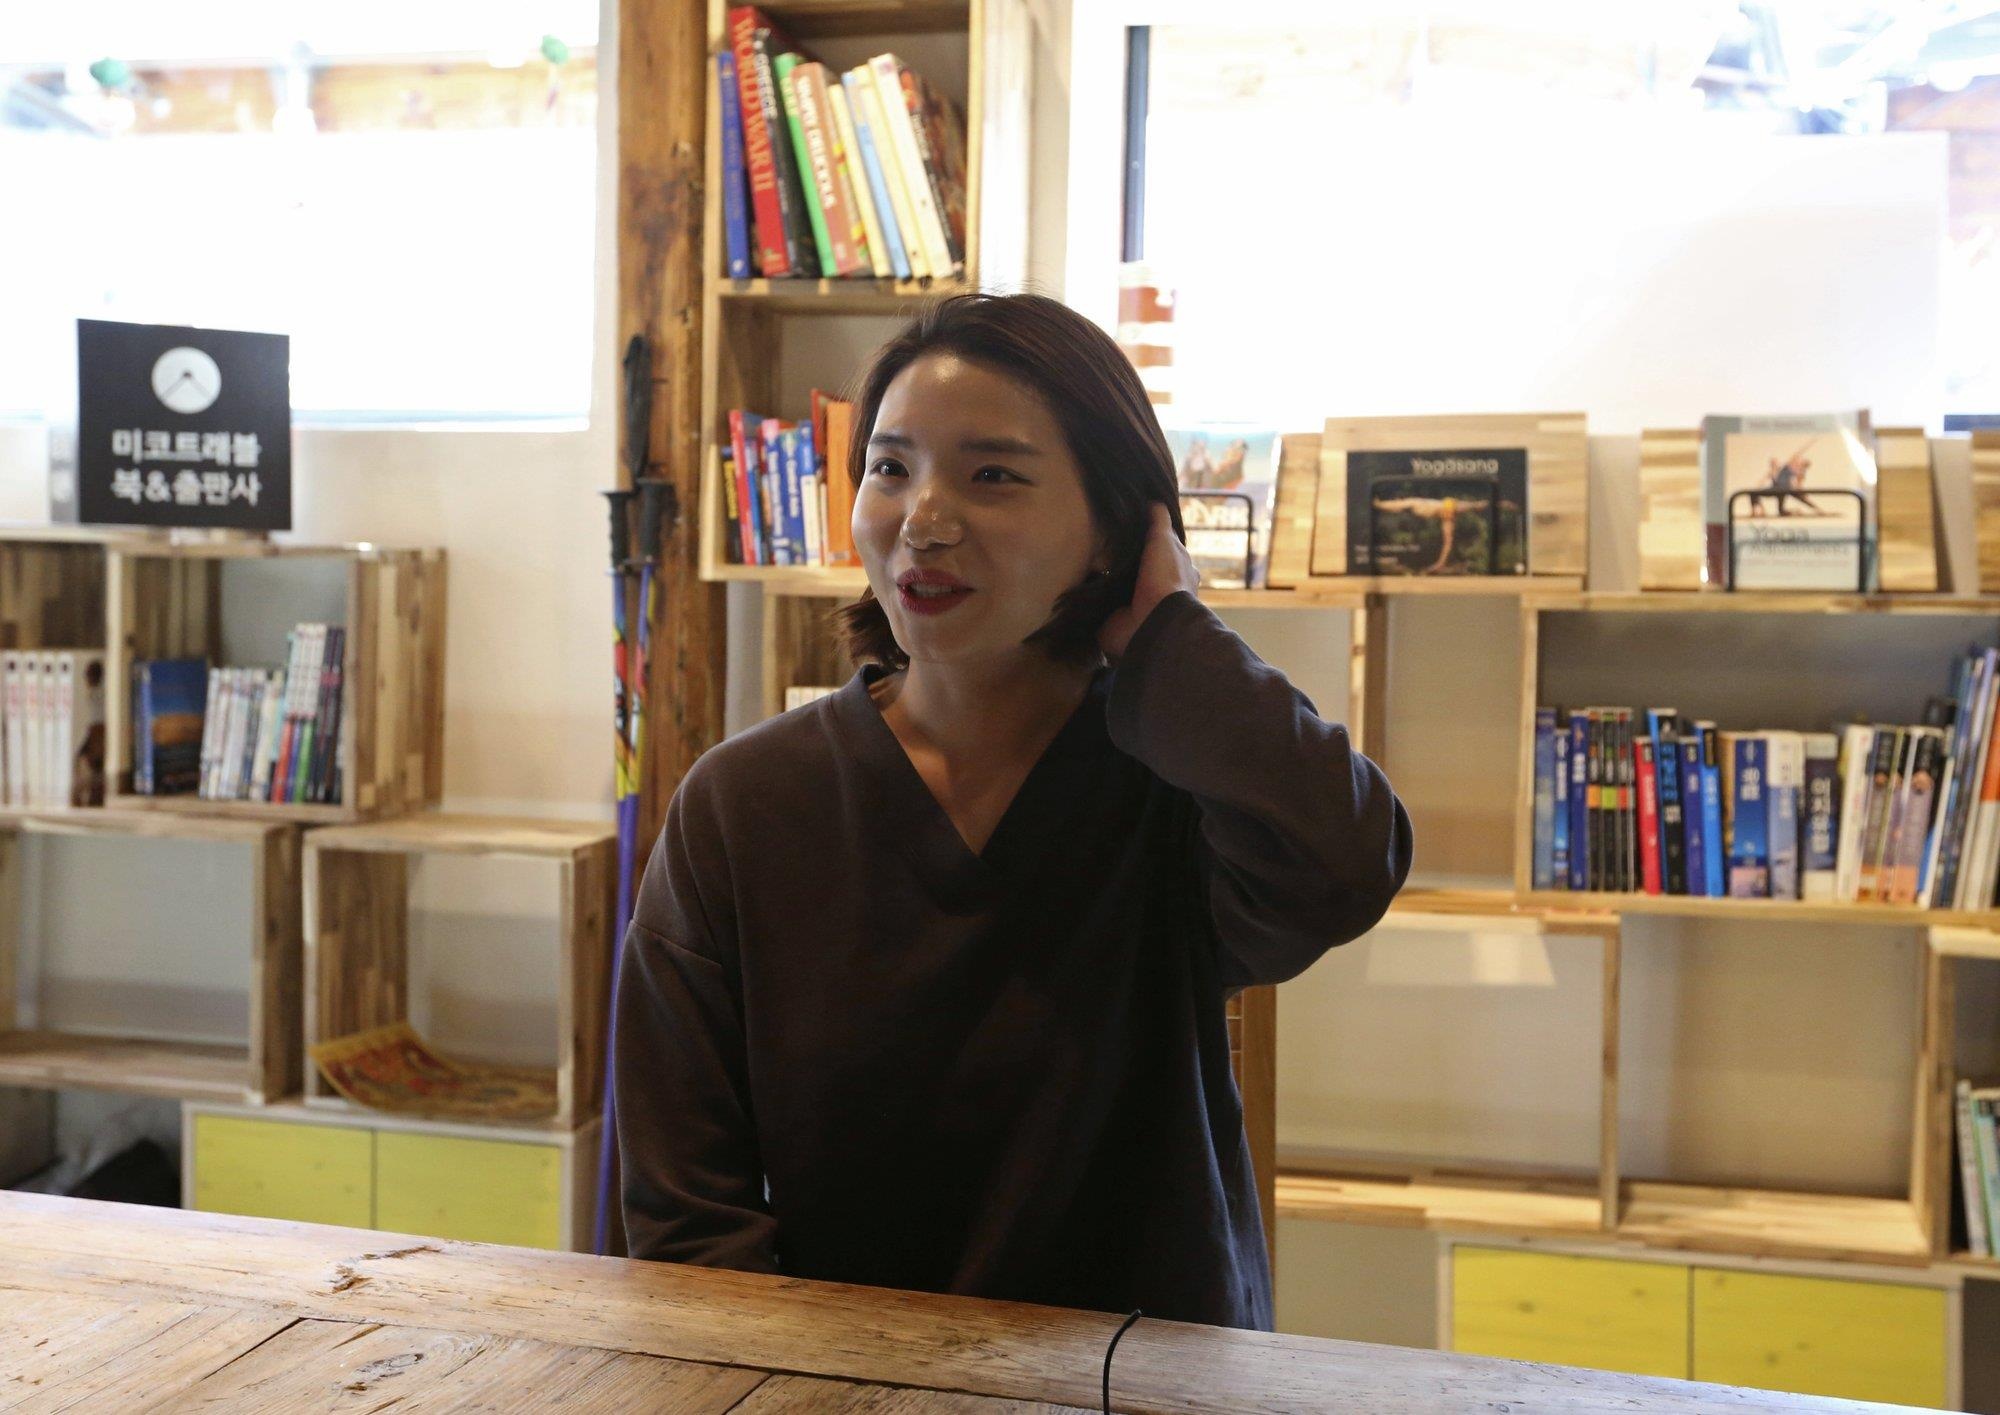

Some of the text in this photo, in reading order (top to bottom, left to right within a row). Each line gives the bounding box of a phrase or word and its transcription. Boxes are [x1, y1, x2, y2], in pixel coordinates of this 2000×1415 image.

[735, 17, 776, 192] WORLD WAR II
[755, 53, 778, 119] GREECE
[806, 127, 837, 210] DELICIOUS
[111, 427, 262, 467] 미코트레블
[110, 467, 262, 507] 북&출판사
